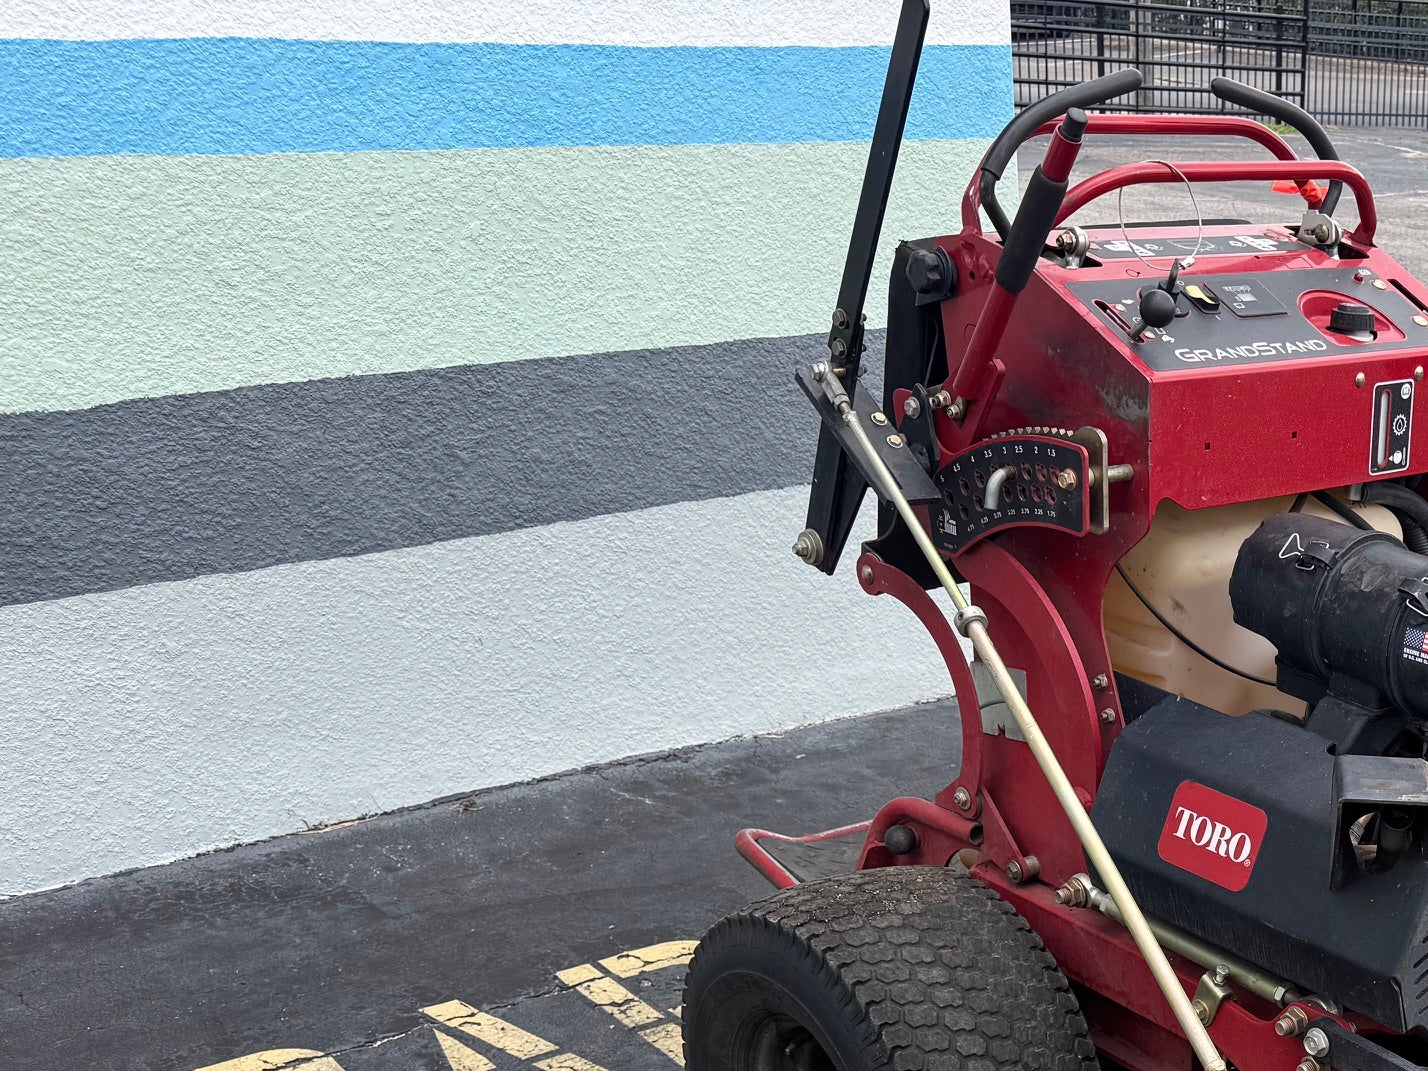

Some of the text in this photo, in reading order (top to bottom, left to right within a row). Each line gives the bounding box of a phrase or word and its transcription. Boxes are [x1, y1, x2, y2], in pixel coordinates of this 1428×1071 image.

[984, 449, 993, 459] 3.5
[1002, 446, 1007, 455] 3
[1014, 445, 1024, 454] 2.5
[1034, 446, 1039, 454] 2
[1047, 448, 1056, 458] 1.5
[1173, 806, 1252, 863] TORO
